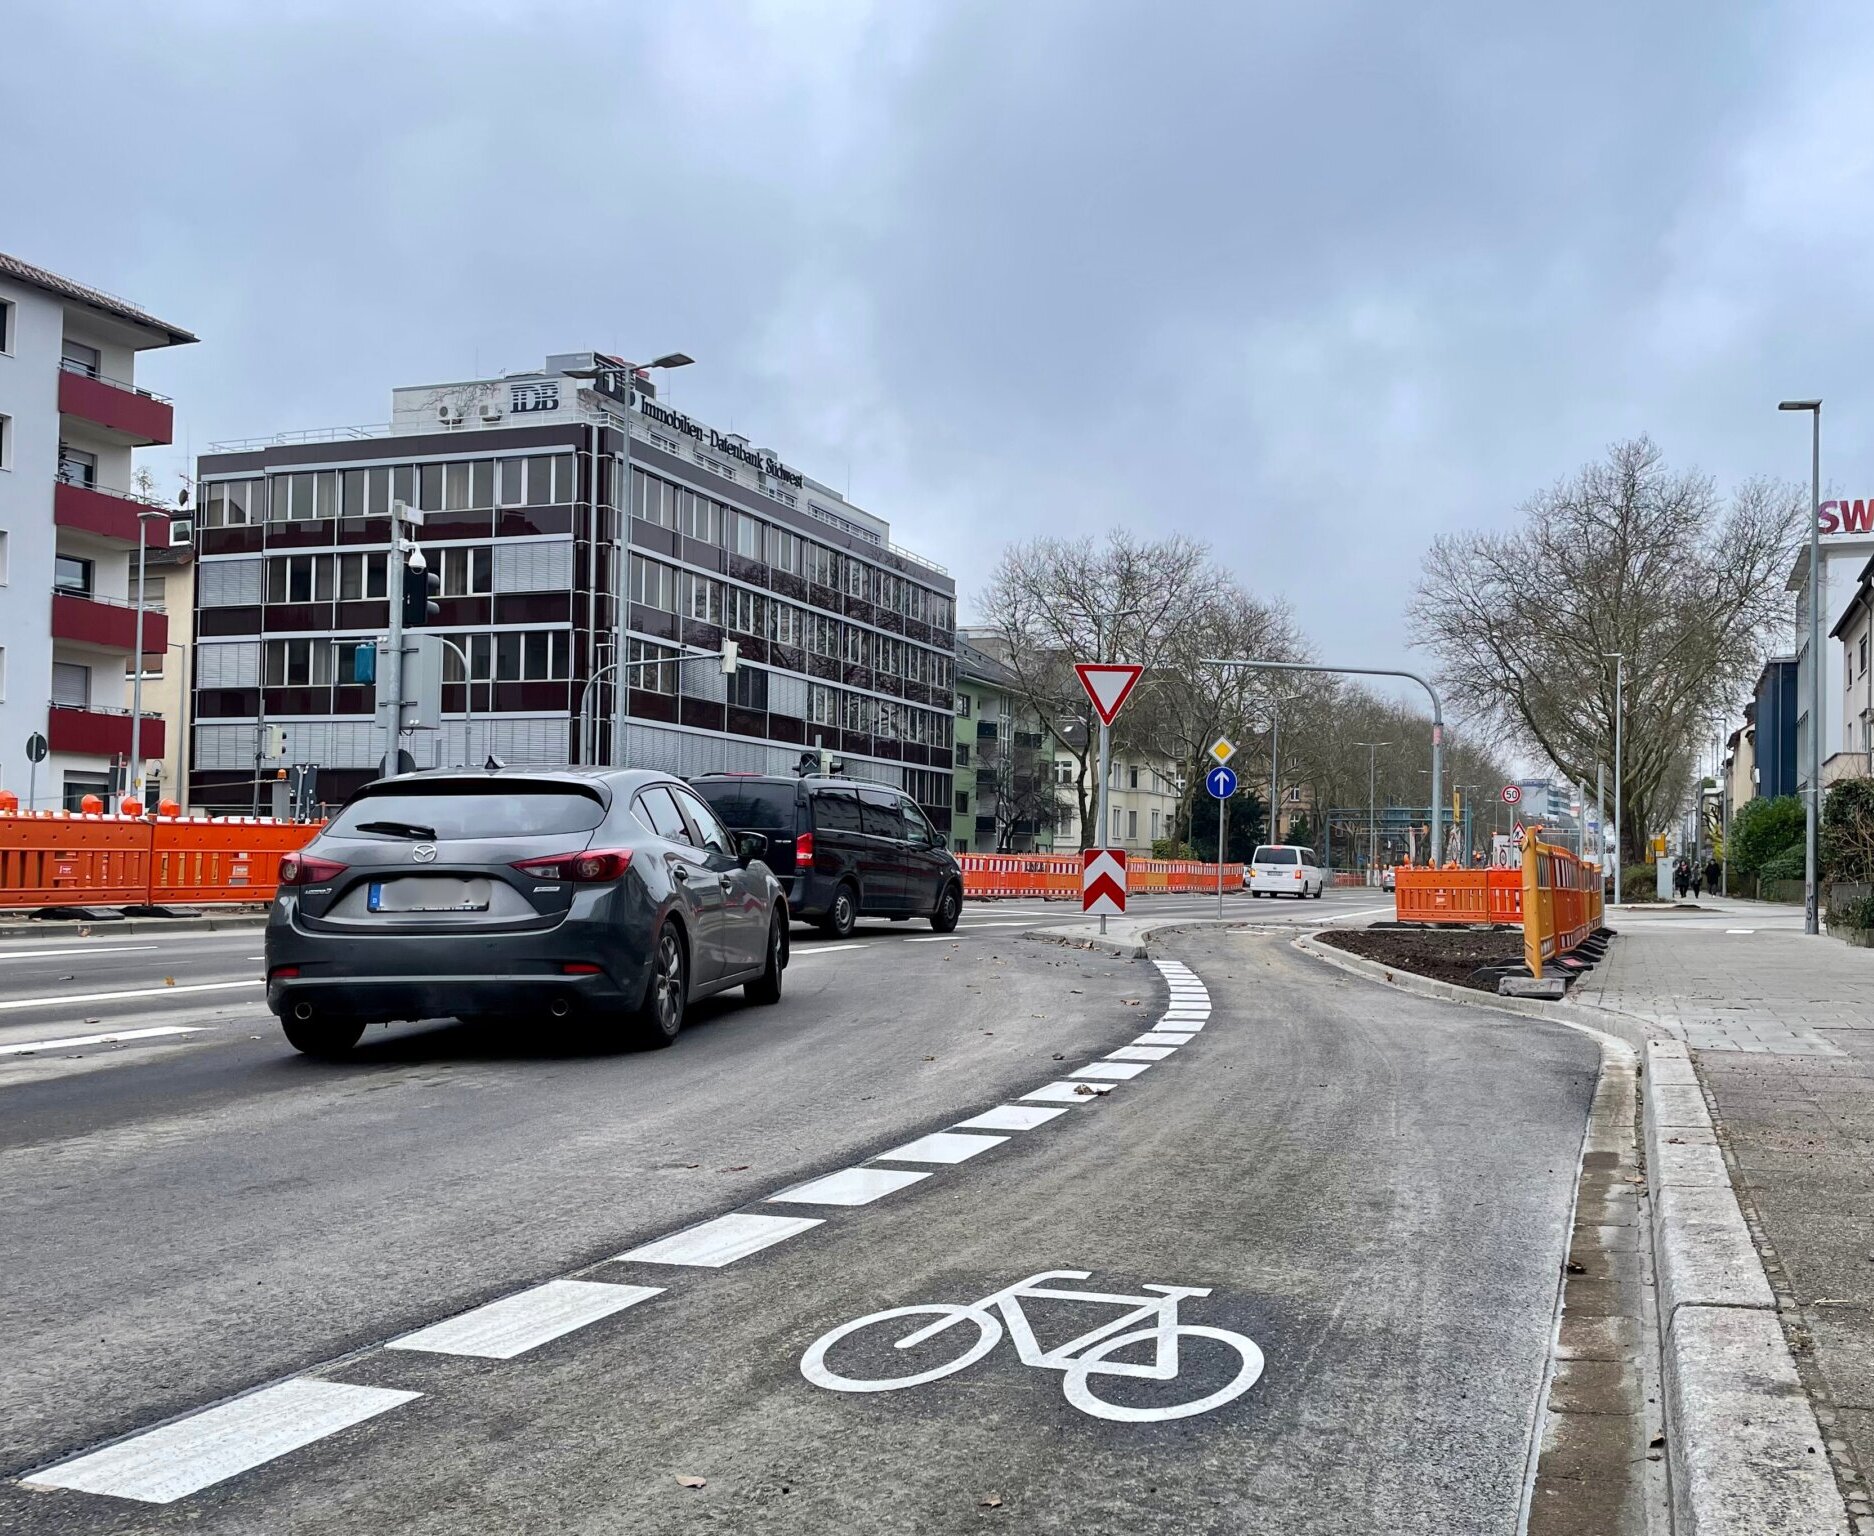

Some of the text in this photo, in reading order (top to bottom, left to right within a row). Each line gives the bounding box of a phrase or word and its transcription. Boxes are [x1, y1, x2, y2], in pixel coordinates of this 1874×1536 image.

[510, 381, 559, 413] IDB
[641, 395, 763, 471] Immobilien-Datenbank
[766, 457, 804, 489] Südwest
[1506, 790, 1518, 799] 50
